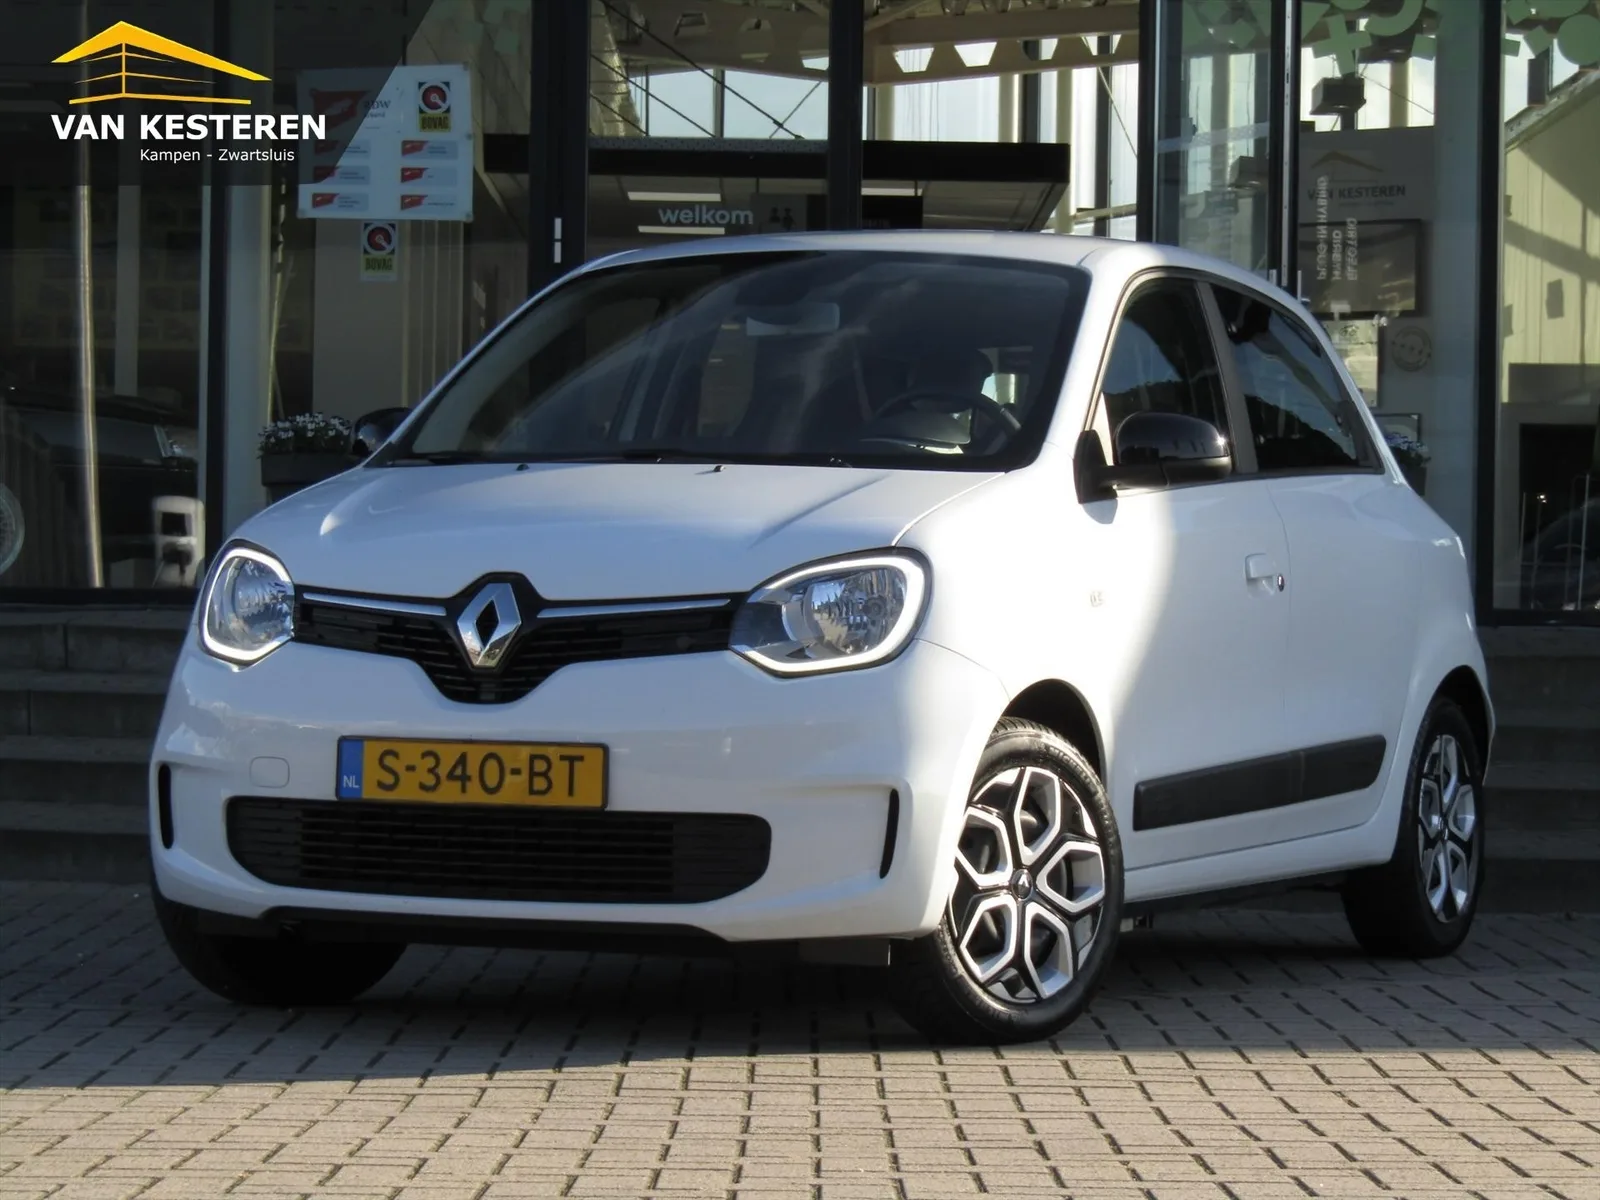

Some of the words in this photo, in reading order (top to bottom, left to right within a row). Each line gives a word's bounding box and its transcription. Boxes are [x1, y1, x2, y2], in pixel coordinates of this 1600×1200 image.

[421, 114, 450, 131] BOVAG
[1338, 185, 1405, 199] KESTEREN
[657, 204, 754, 225] welkom
[365, 257, 393, 271] BOVAG
[376, 748, 585, 797] S-340-BT
[343, 775, 360, 789] NL
